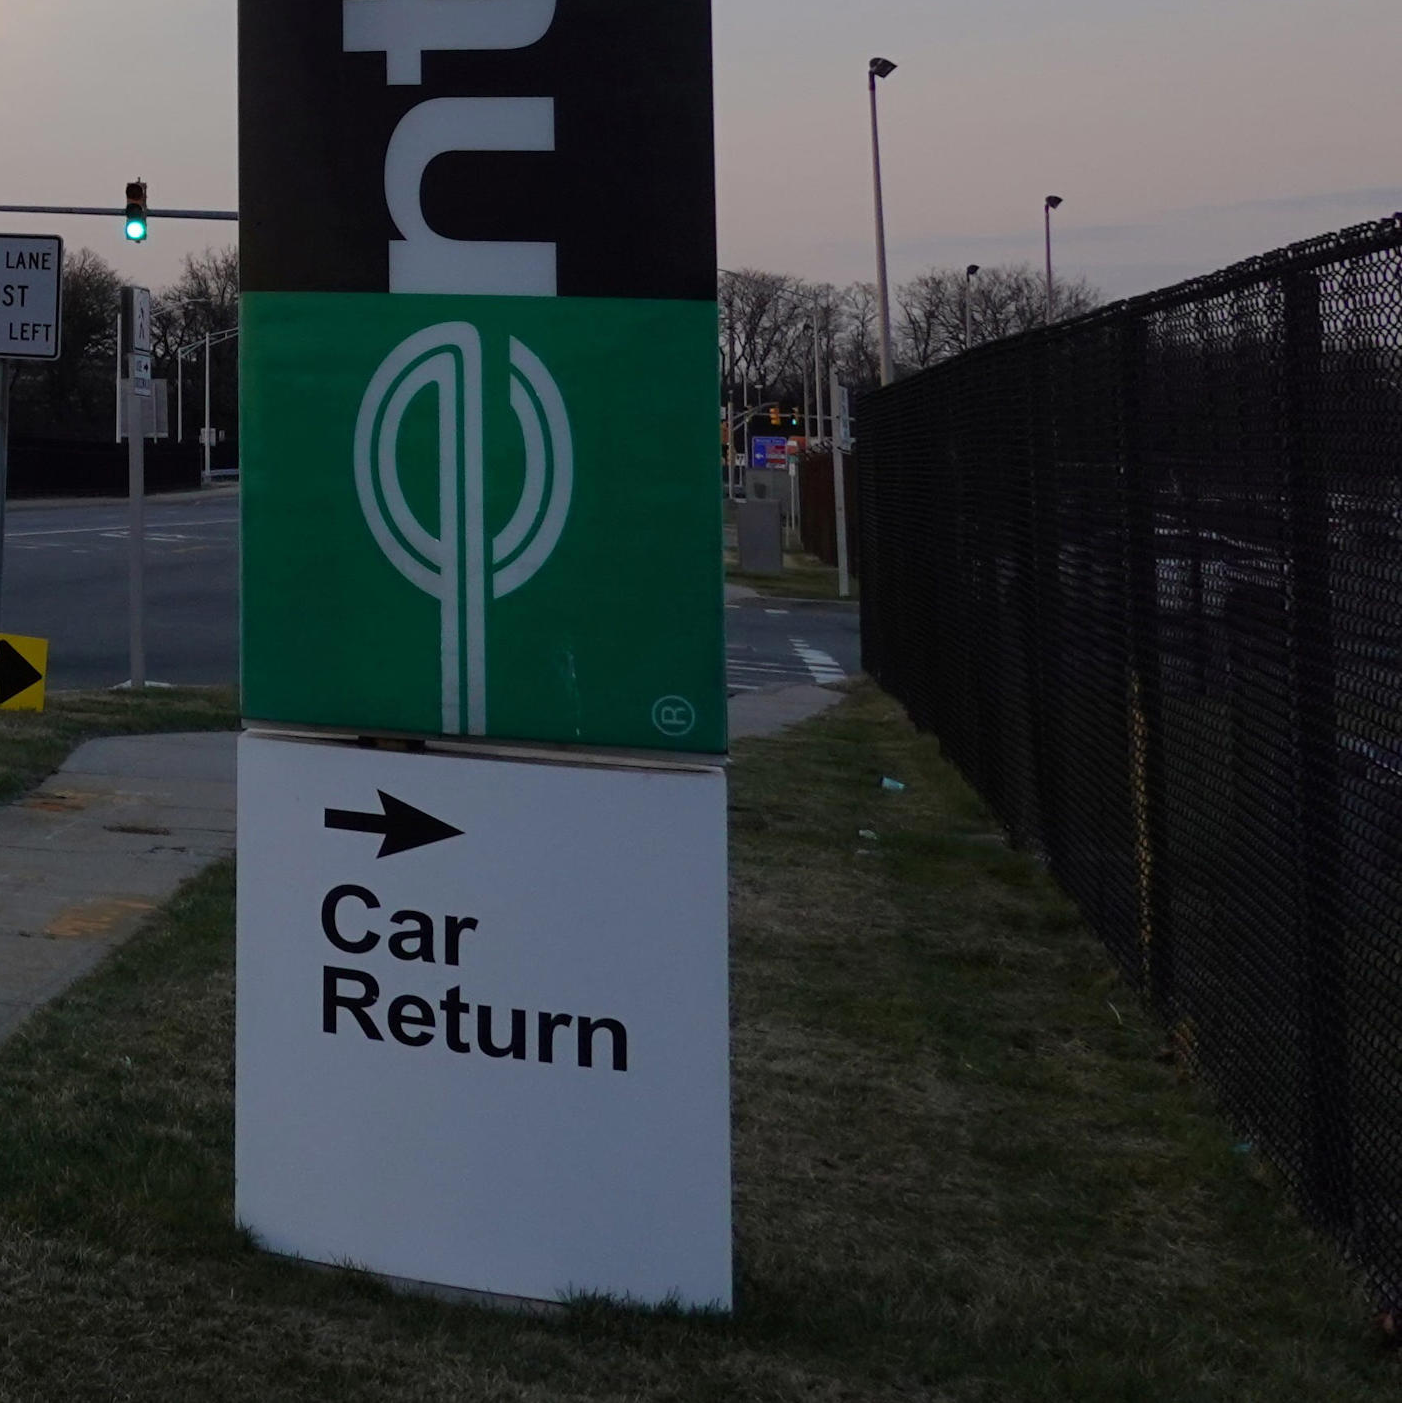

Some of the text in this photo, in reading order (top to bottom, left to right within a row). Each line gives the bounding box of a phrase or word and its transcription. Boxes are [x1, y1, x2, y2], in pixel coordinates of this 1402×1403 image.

[6, 251, 52, 270] LANE
[9, 322, 52, 342] LEFT
[321, 884, 479, 966] Car
[322, 965, 628, 1072] Return
